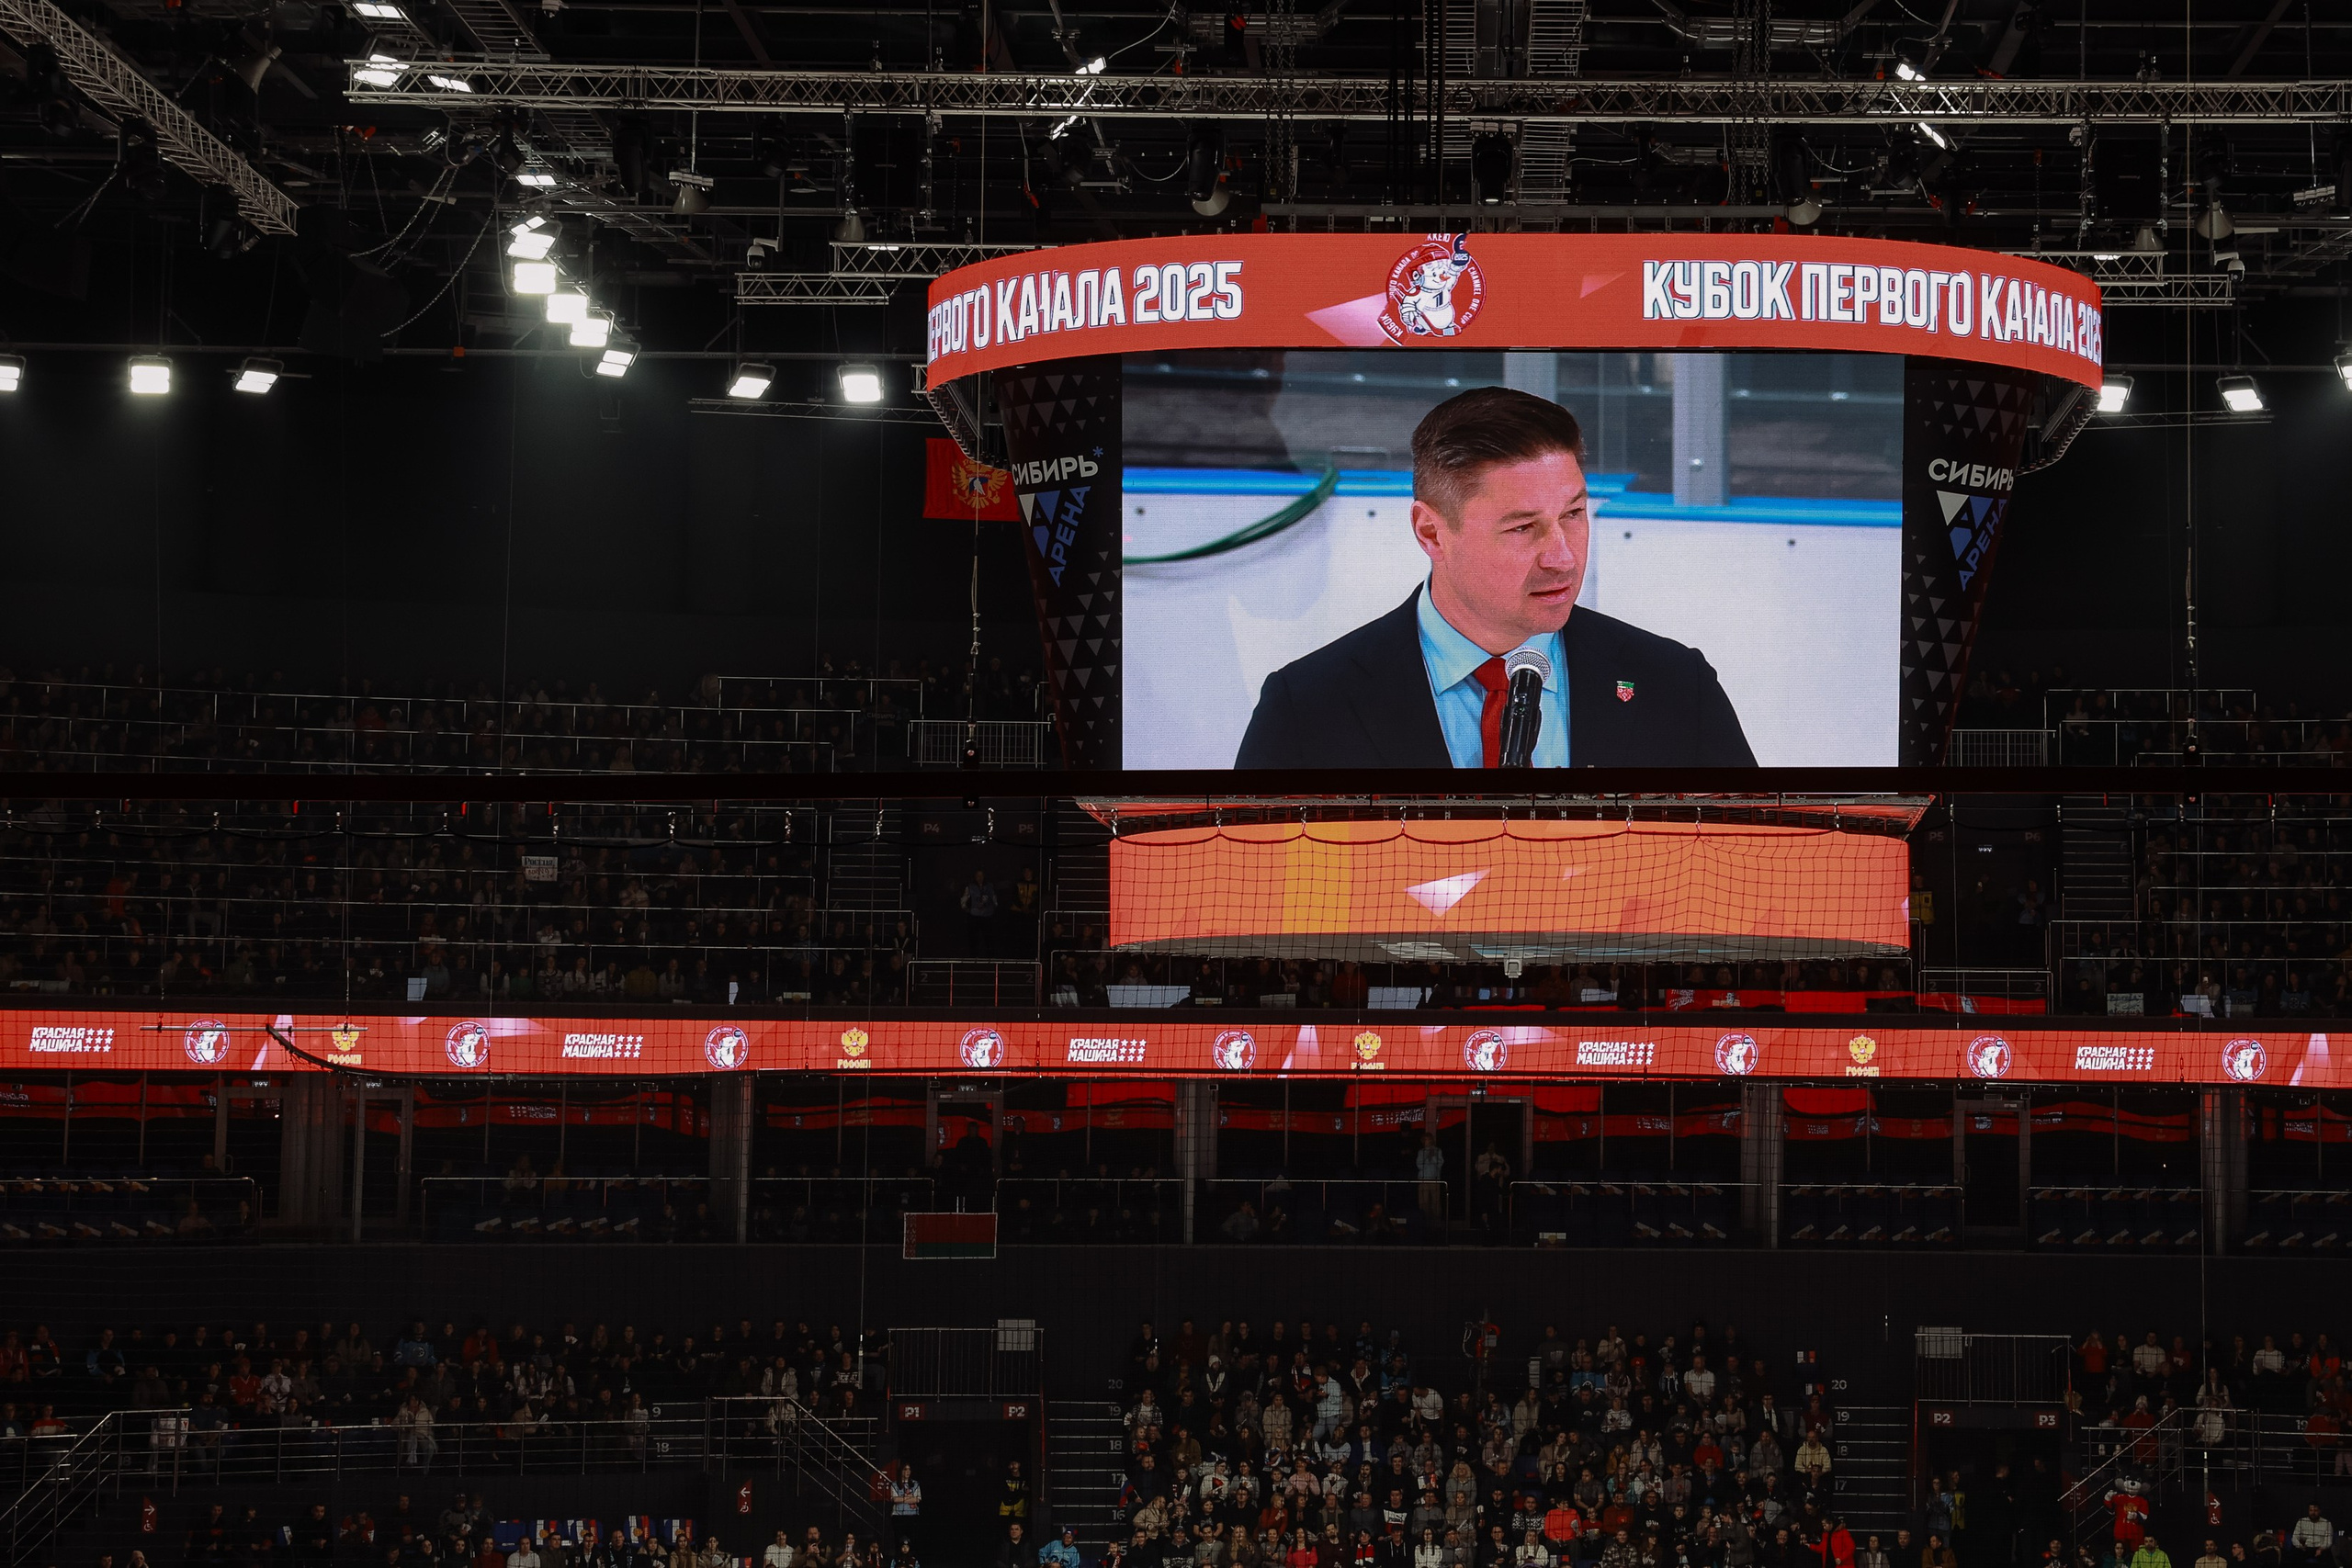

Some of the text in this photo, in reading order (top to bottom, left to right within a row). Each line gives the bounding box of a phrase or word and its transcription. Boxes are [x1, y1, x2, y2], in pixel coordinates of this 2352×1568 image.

[1133, 261, 1244, 323] 2025
[1460, 266, 1482, 325] CHANNEL ONE CUP
[1644, 260, 1795, 321] КУБОК
[1801, 263, 1974, 336] ПЕРВОГО
[1012, 455, 1099, 486] СИБИРЬ
[1928, 457, 2014, 491] СИБИРЬ
[1048, 486, 1091, 588] АРЕНА
[1959, 499, 2007, 592] АРЕНА
[923, 823, 940, 833] P4
[1019, 824, 1034, 834] P5
[1930, 831, 1944, 841] P5
[2025, 831, 2041, 842] P6
[921, 974, 928, 983] 2
[1025, 974, 1034, 984] 2
[1929, 981, 1937, 991] 2
[2034, 982, 2041, 992] 2
[31, 1027, 85, 1039] КРАСНАЯ
[564, 1034, 616, 1044] КРАСНАЯ
[1069, 1039, 1120, 1049] КРАСНАЯ
[29, 1039, 83, 1052] МАШИНА
[561, 1045, 614, 1057] МАШИНА
[1578, 1042, 1628, 1052] КРАСНАЯ
[1068, 1050, 1117, 1062] МАШИНА
[2076, 1046, 2127, 1057] КРАСНАЯ
[1576, 1053, 1626, 1065] МАШИНА
[2075, 1057, 2125, 1070] МАШИНА
[1108, 1379, 1123, 1390] 20
[1831, 1380, 1848, 1390] 20
[652, 1406, 662, 1417] 9
[905, 1406, 919, 1417] P1
[1008, 1406, 1025, 1417] P2
[1108, 1405, 1121, 1416] 19
[1837, 1411, 1850, 1421] 19
[1933, 1413, 1951, 1424] P2
[2039, 1415, 2056, 1426] P3
[656, 1442, 669, 1453] 18
[1109, 1439, 1123, 1450] 18
[1838, 1445, 1849, 1456] 18
[1835, 1480, 1847, 1491] 17
[1112, 1509, 1125, 1520] 16
